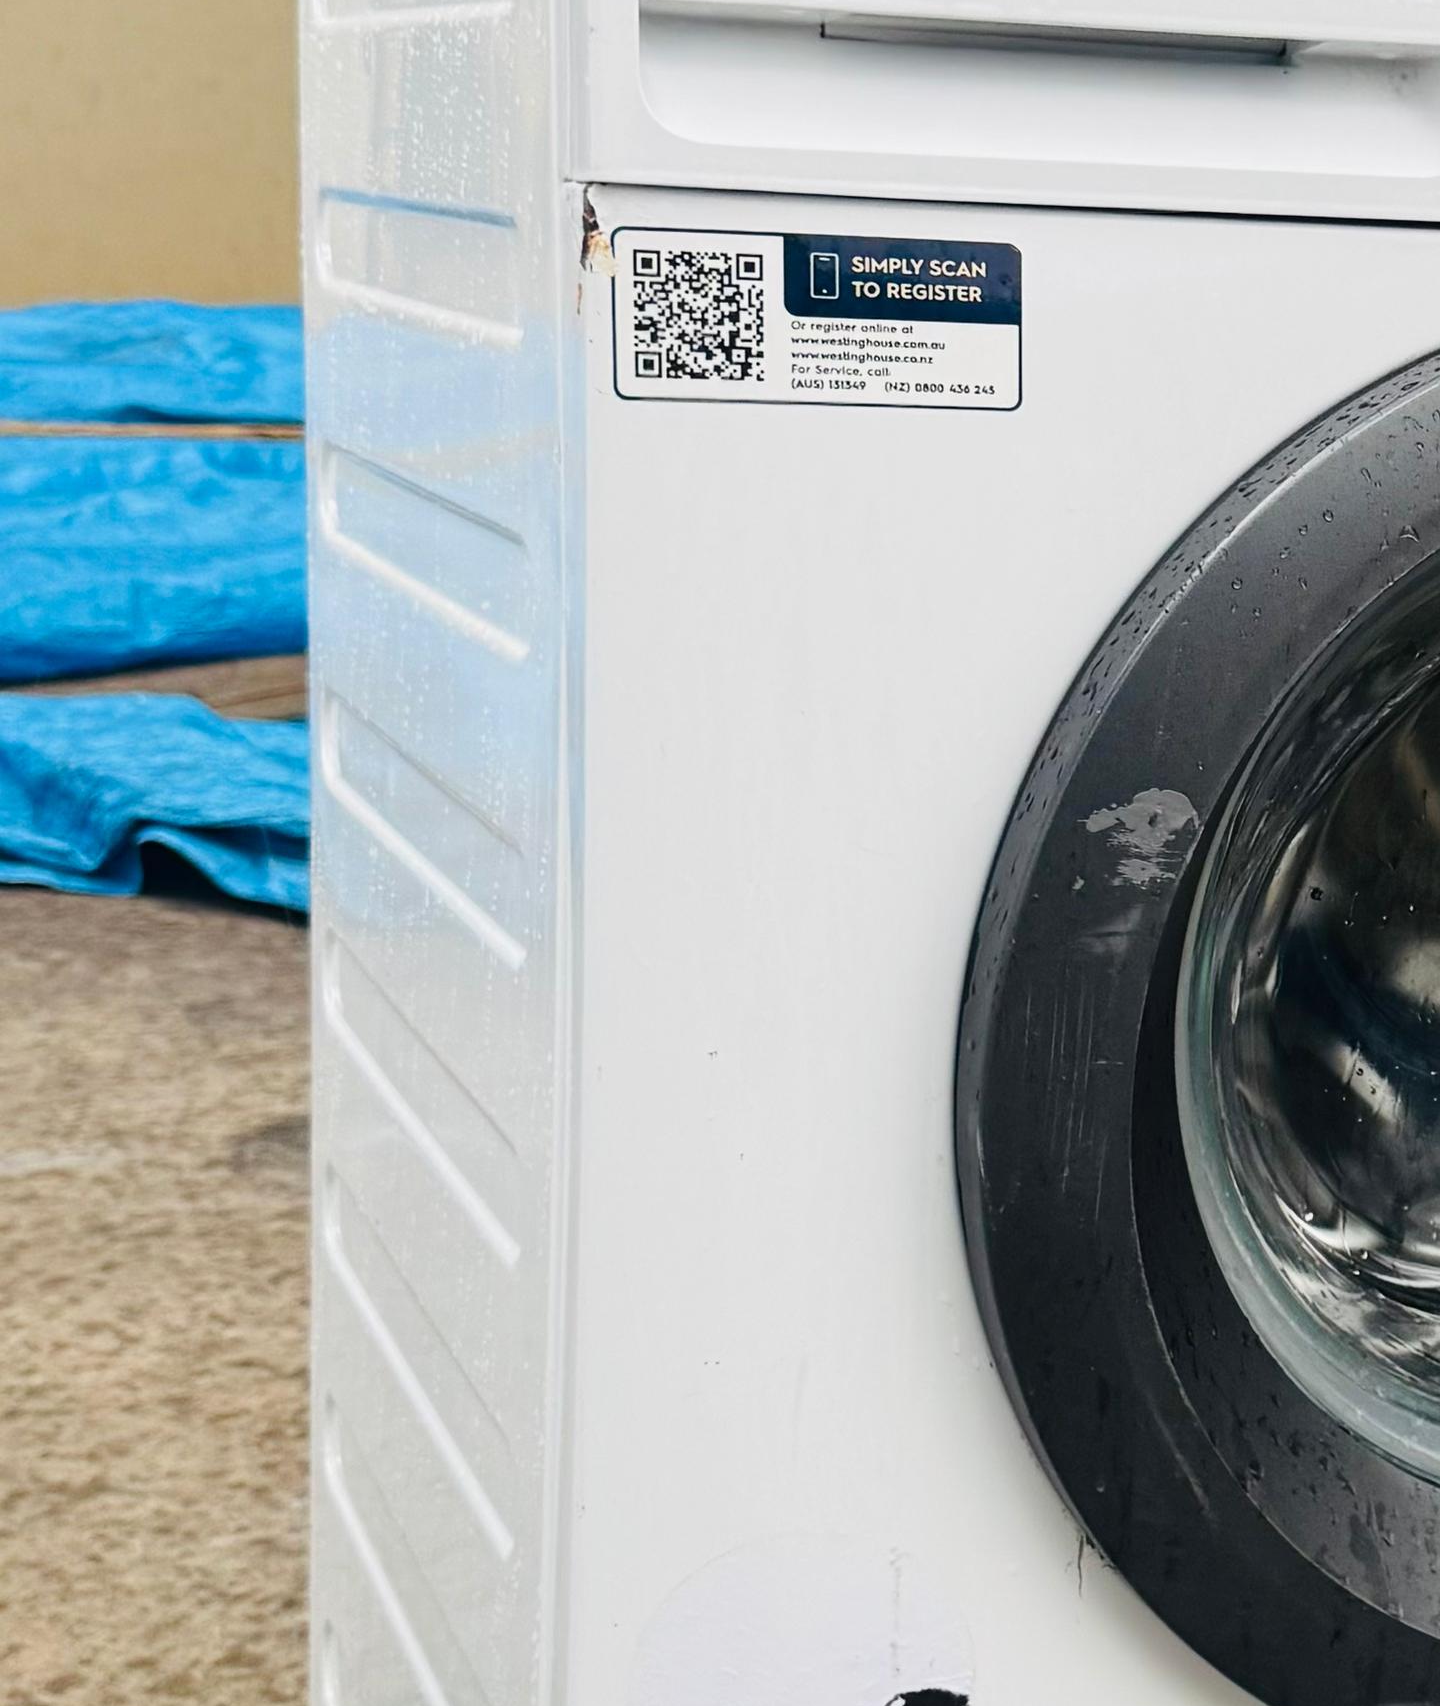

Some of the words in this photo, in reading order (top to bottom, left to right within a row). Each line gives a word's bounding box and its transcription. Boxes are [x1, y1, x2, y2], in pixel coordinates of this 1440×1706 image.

[851, 256, 925, 276] SIMPLY
[929, 259, 987, 278] SCAN
[851, 281, 881, 299] TO
[886, 282, 983, 303] REGISTER
[791, 320, 806, 331] Or
[810, 322, 857, 334] register
[861, 324, 898, 334] online
[901, 325, 914, 334] at
[791, 364, 811, 374] For
[791, 378, 825, 390] (AUS)
[884, 381, 911, 394] (NZ)
[914, 382, 945, 394] 0800
